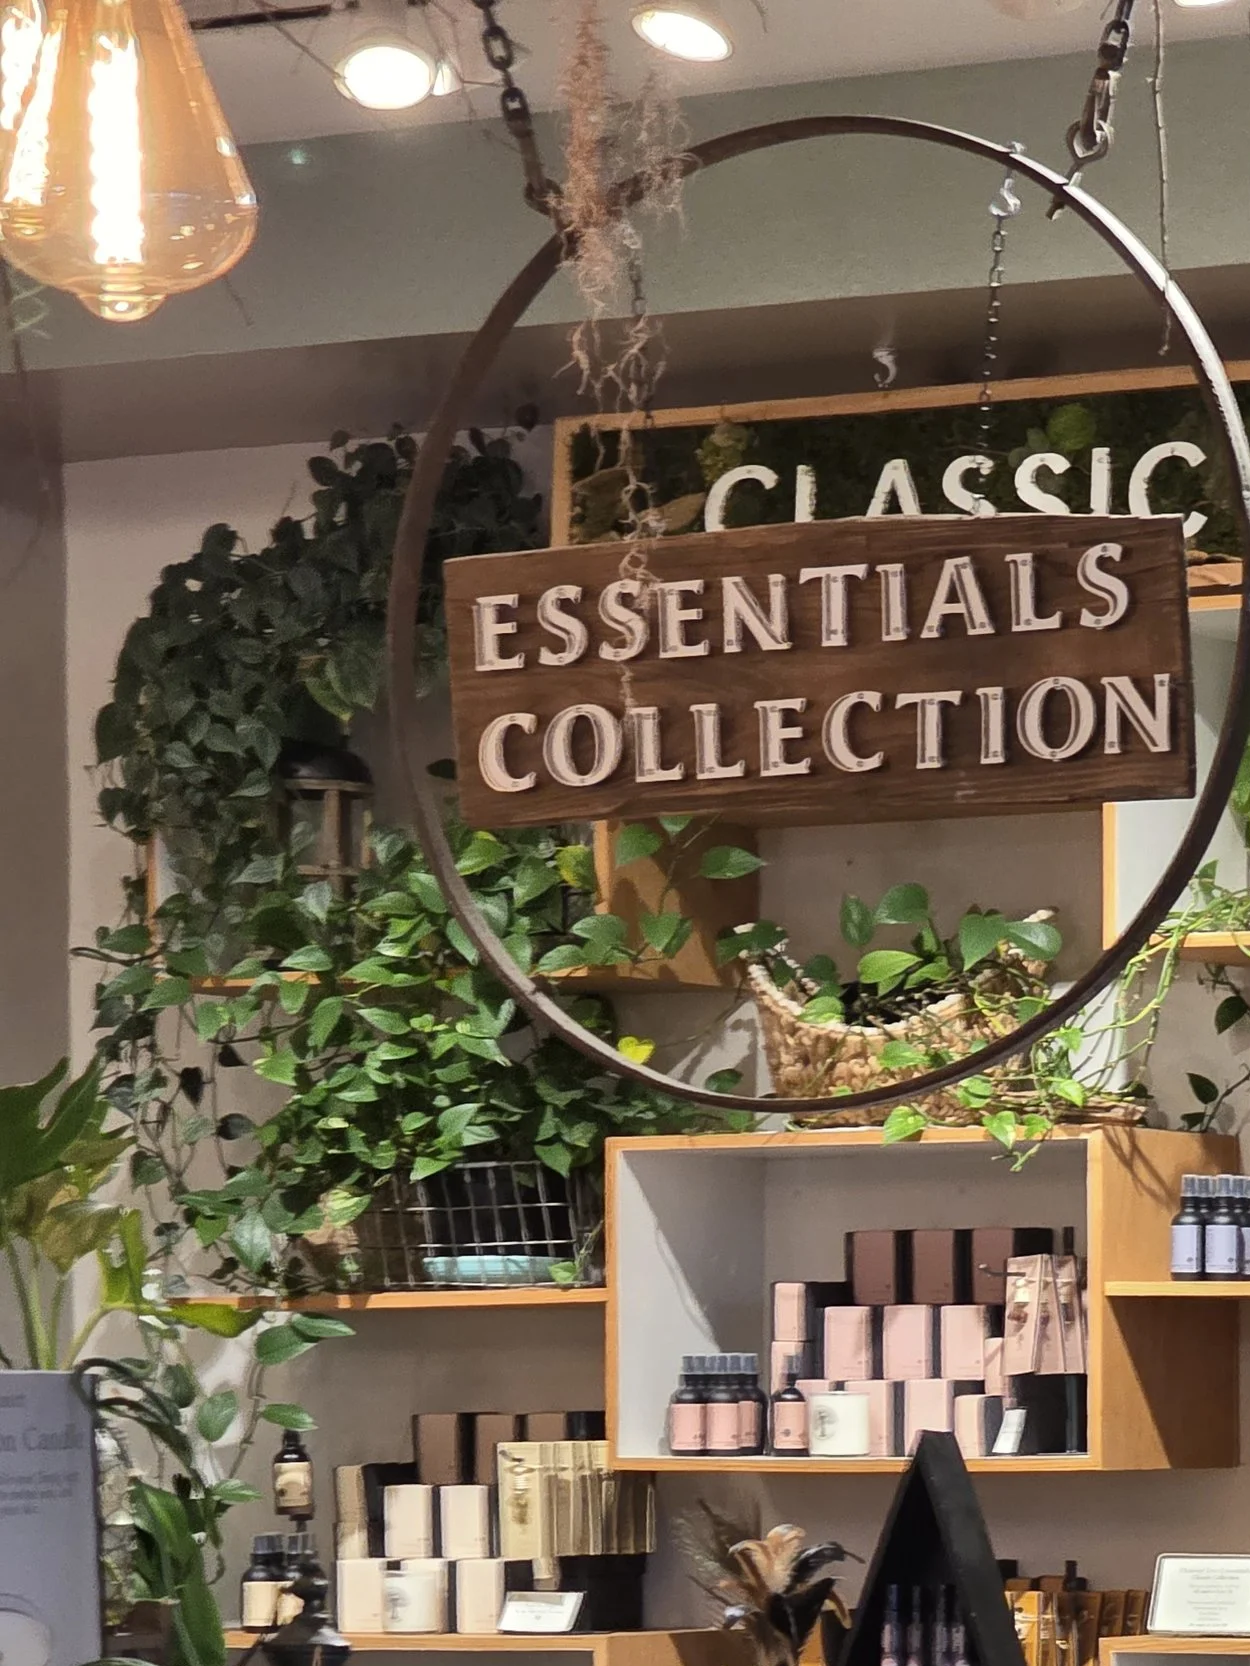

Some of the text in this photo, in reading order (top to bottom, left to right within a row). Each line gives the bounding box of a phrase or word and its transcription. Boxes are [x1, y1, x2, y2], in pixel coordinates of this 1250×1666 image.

[705, 441, 1207, 538] CLASSIC
[474, 542, 1129, 672] ESSENTIALS
[478, 672, 1172, 793] COLLECTION
